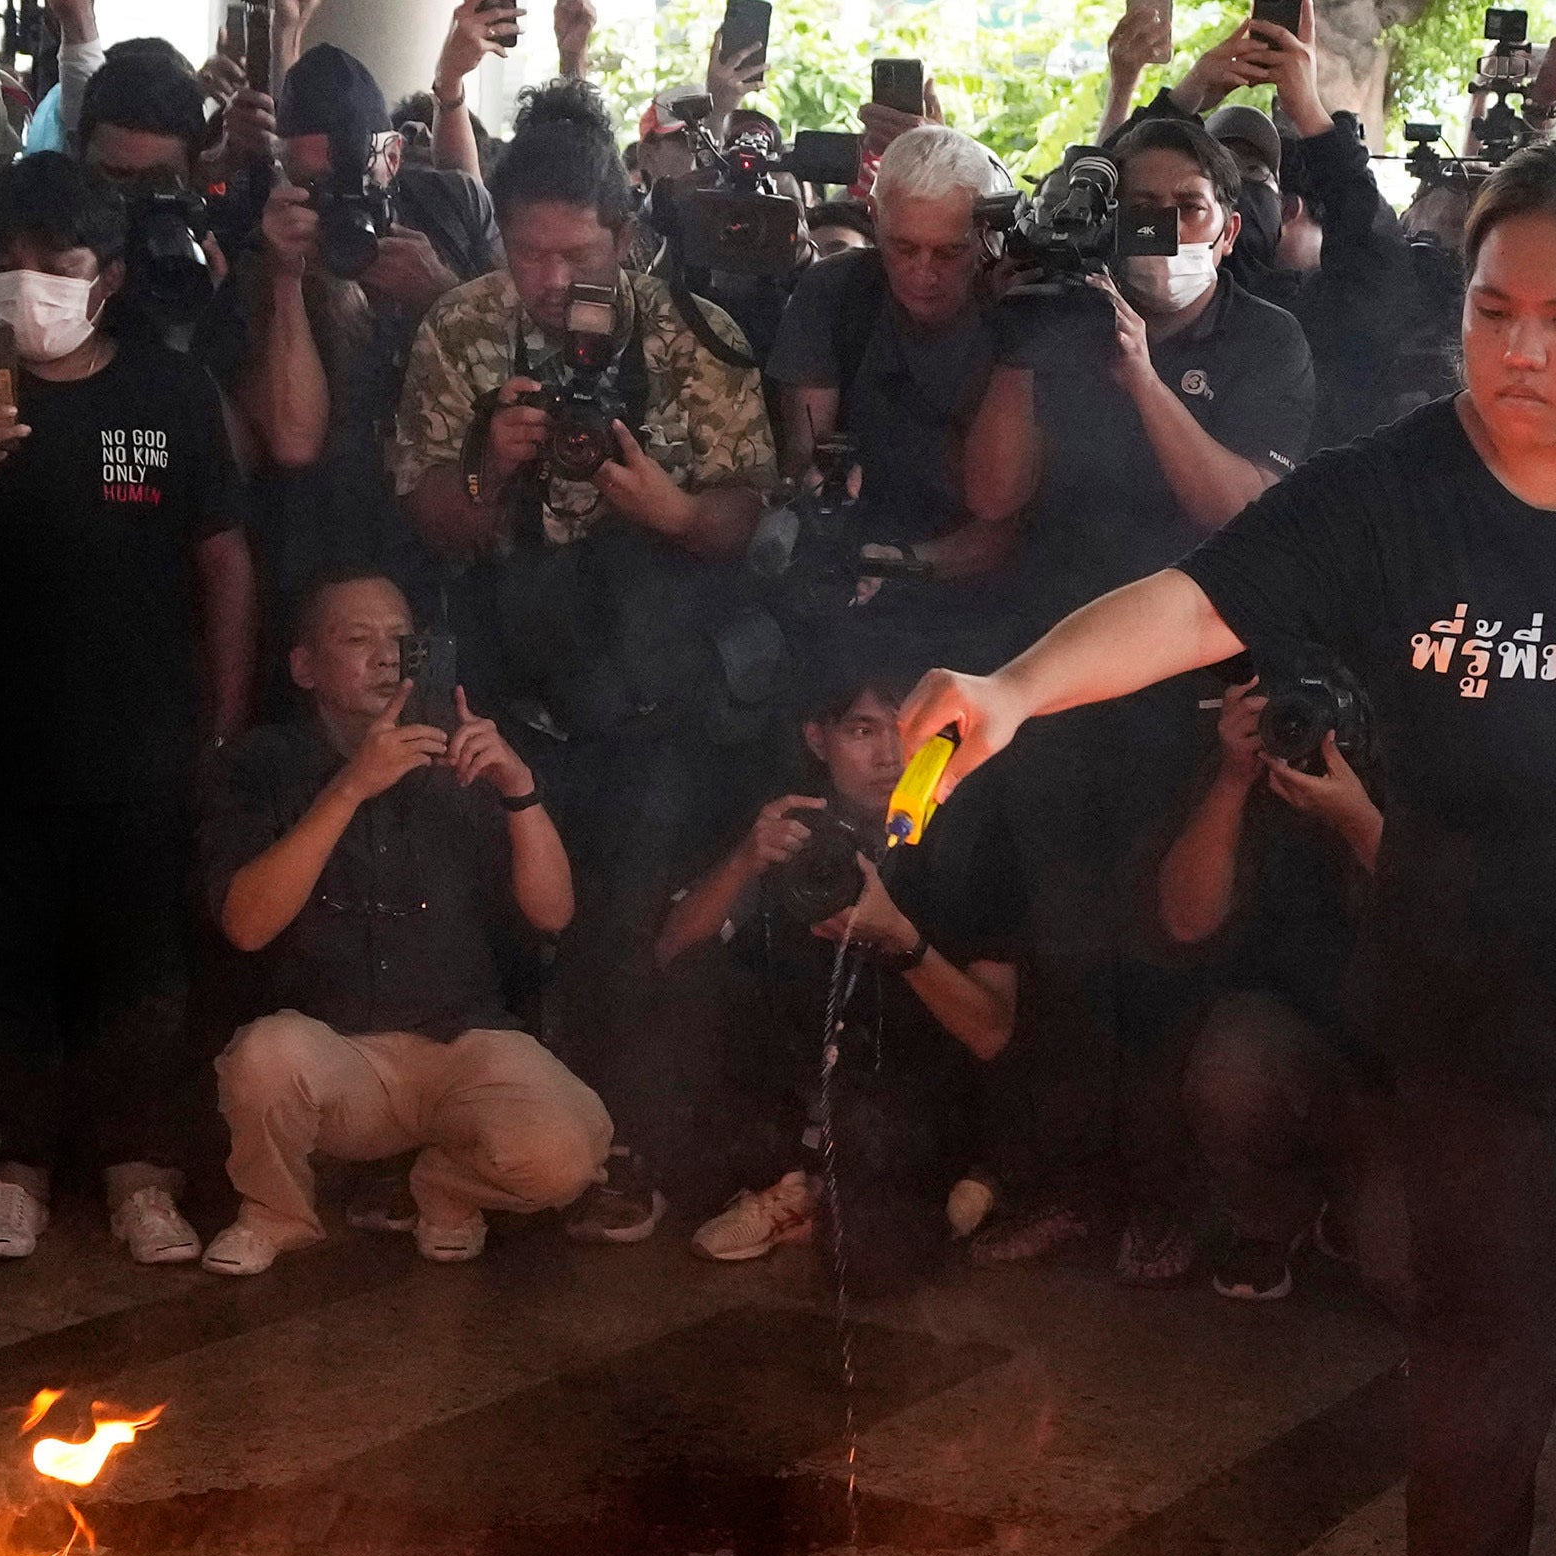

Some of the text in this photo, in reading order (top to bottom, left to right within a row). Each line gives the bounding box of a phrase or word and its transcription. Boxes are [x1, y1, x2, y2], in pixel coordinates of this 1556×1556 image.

[1137, 225, 1156, 235] 4K
[101, 429, 166, 449] NO GOD
[103, 446, 168, 468] NO KING
[103, 464, 146, 483] ONLY
